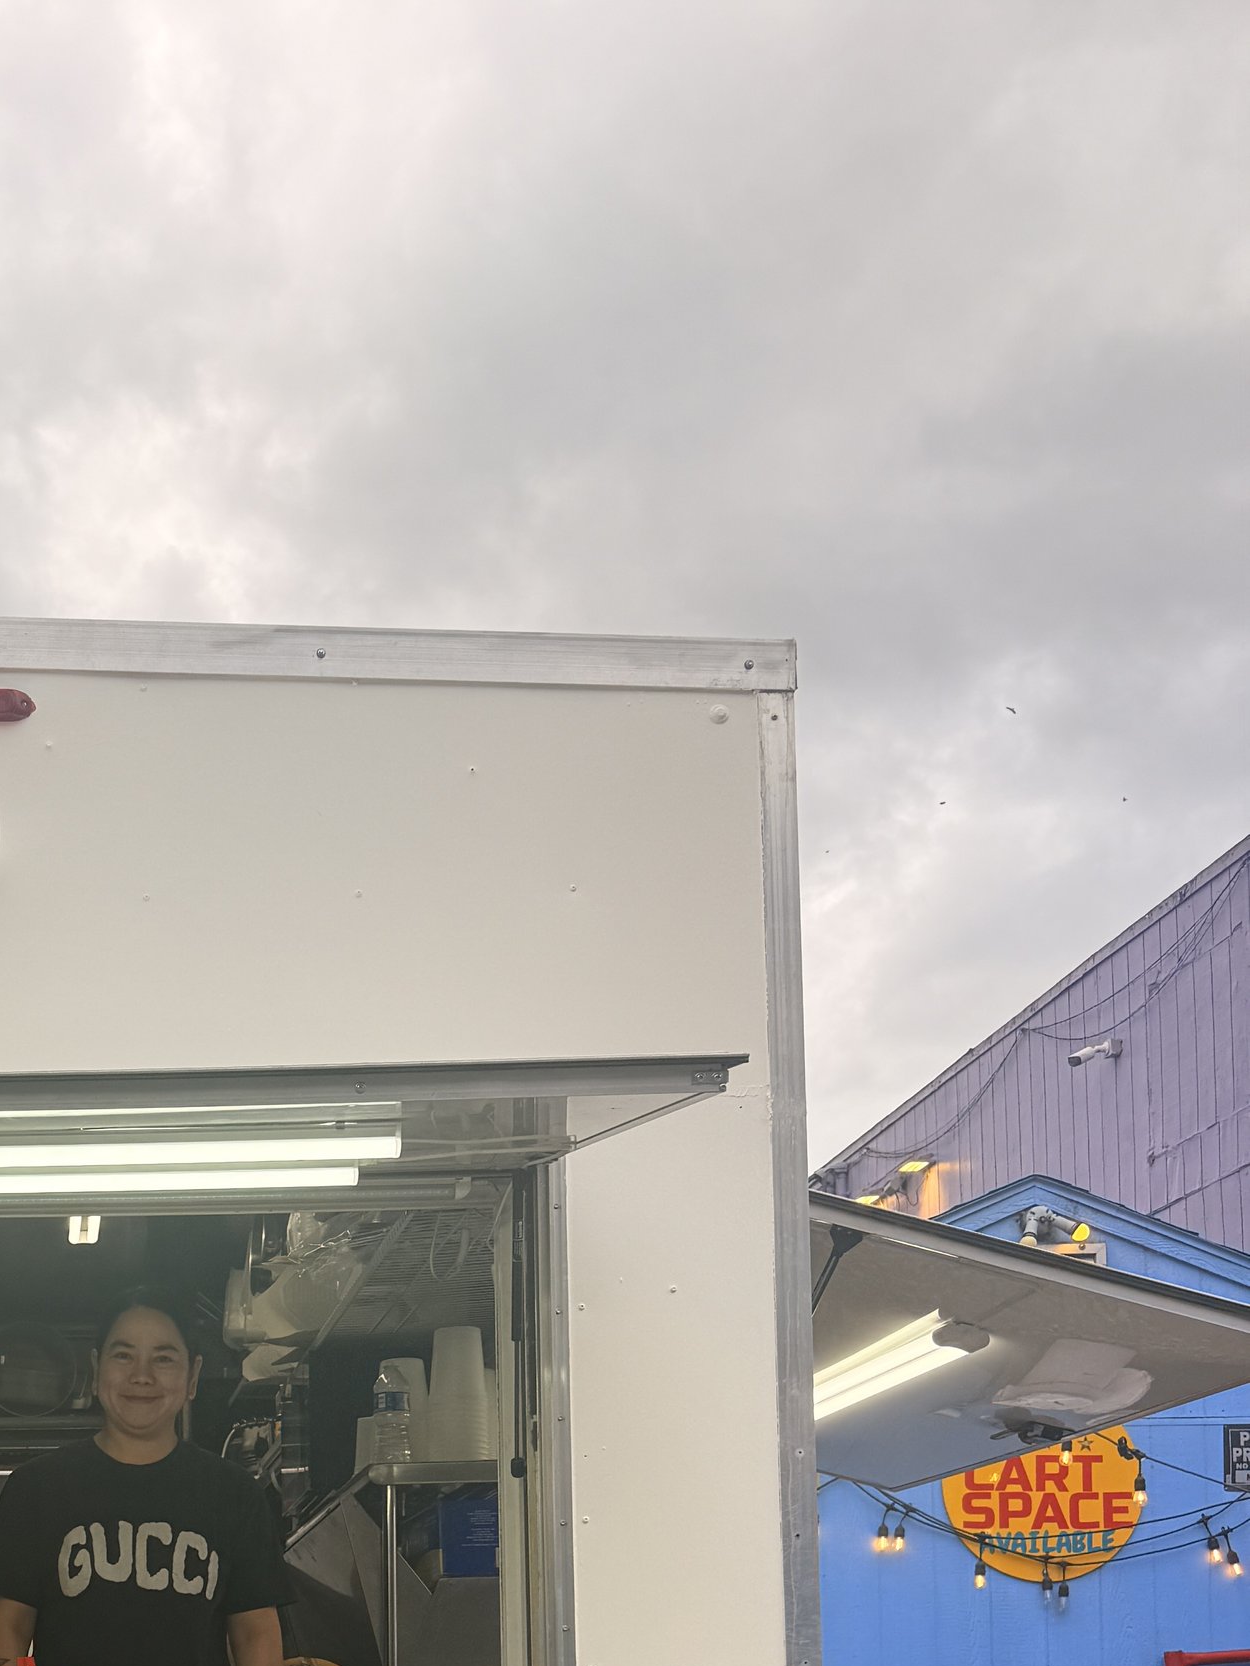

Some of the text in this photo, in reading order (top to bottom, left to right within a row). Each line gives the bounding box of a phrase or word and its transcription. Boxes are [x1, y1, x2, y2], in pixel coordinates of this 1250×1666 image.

[964, 1455, 1103, 1492] CART
[961, 1492, 1136, 1530] SPACE
[57, 1520, 219, 1601] GUCCI
[979, 1529, 1116, 1555] AVAILABLE
